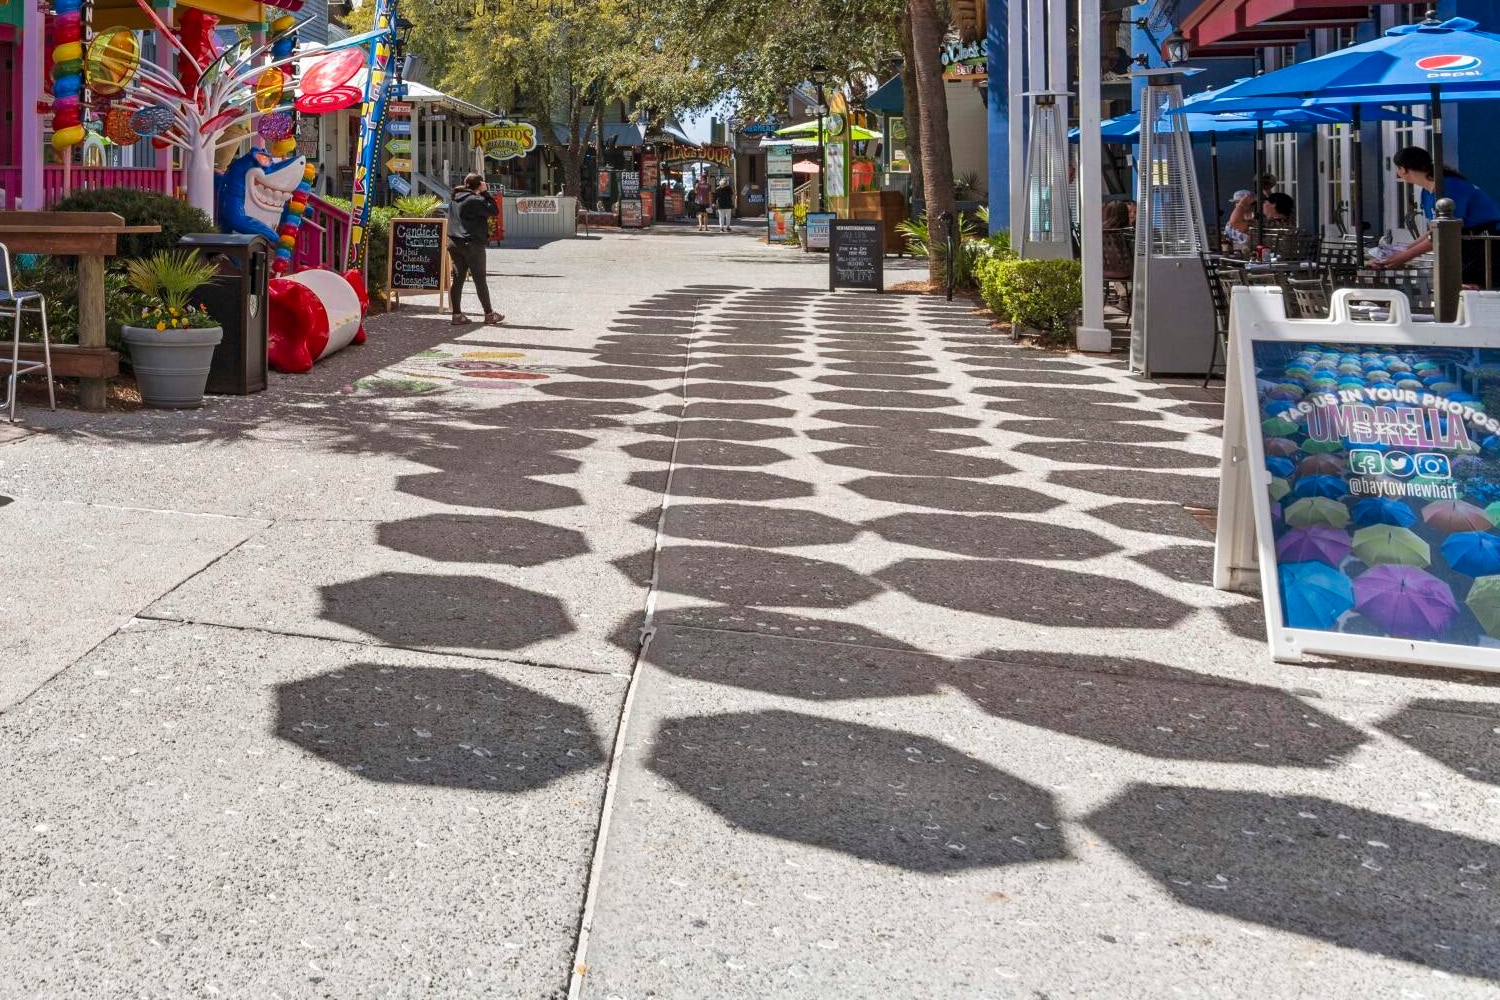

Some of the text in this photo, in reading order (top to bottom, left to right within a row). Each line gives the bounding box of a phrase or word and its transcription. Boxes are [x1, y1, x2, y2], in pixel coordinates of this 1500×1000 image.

[1427, 70, 1482, 79] pepsi
[473, 128, 533, 149] ROBERTO'S
[621, 171, 639, 180] FREE
[397, 224, 439, 238] Candied
[1277, 402, 1313, 423] TAG
[1312, 393, 1339, 408] US
[1338, 387, 1364, 402] IN
[1364, 387, 1417, 404] YOUR
[1306, 402, 1472, 450] UMBRELLA
[1352, 421, 1422, 437] SKY
[1349, 477, 1458, 500] @baytownewharf
